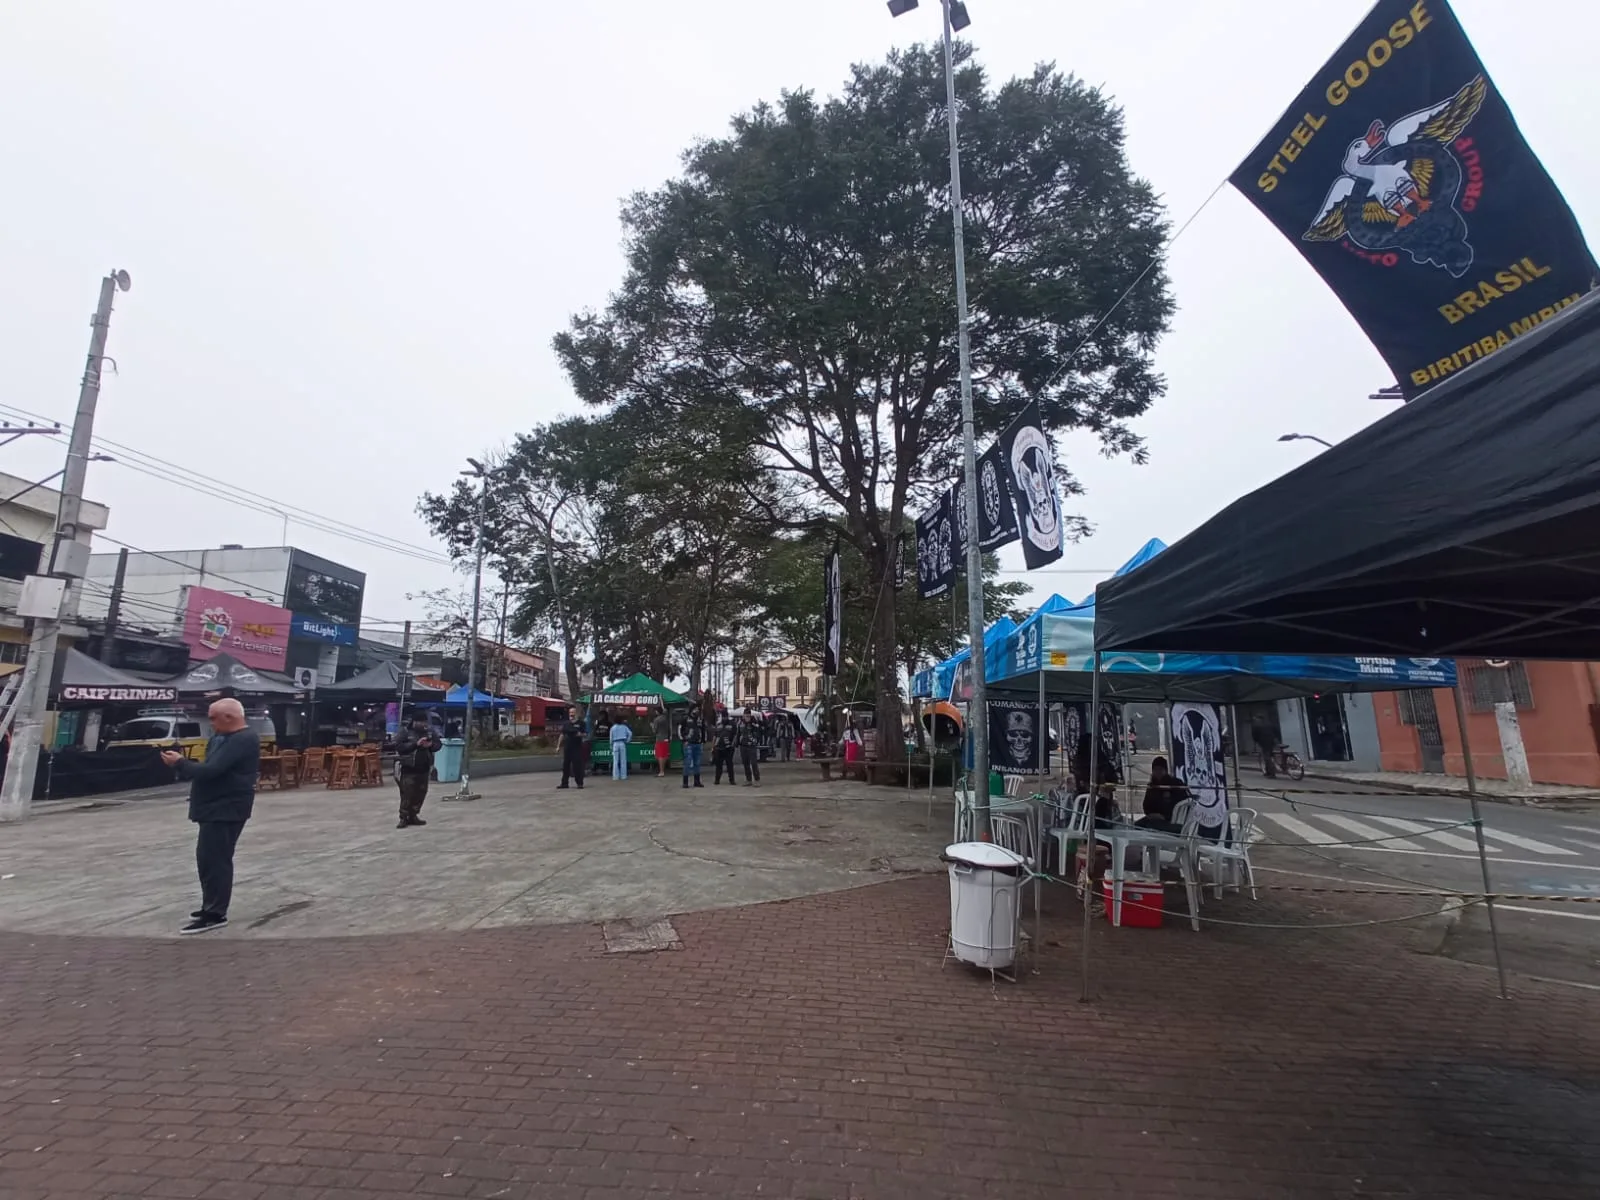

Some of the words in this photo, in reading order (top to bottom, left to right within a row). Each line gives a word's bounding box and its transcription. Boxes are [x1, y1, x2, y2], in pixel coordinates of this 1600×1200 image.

[1258, 112, 1328, 192] STEEL
[1326, 0, 1433, 106] GOOSE
[1438, 257, 1551, 324] BRASIL
[1410, 330, 1511, 386] BIRITIBA
[303, 621, 336, 638] BitLight
[1360, 664, 1394, 674] Mirim
[63, 687, 175, 700] CAIPIRINHAS
[594, 693, 603, 704] LA
[604, 695, 624, 705] CASA
[625, 695, 637, 705] DO
